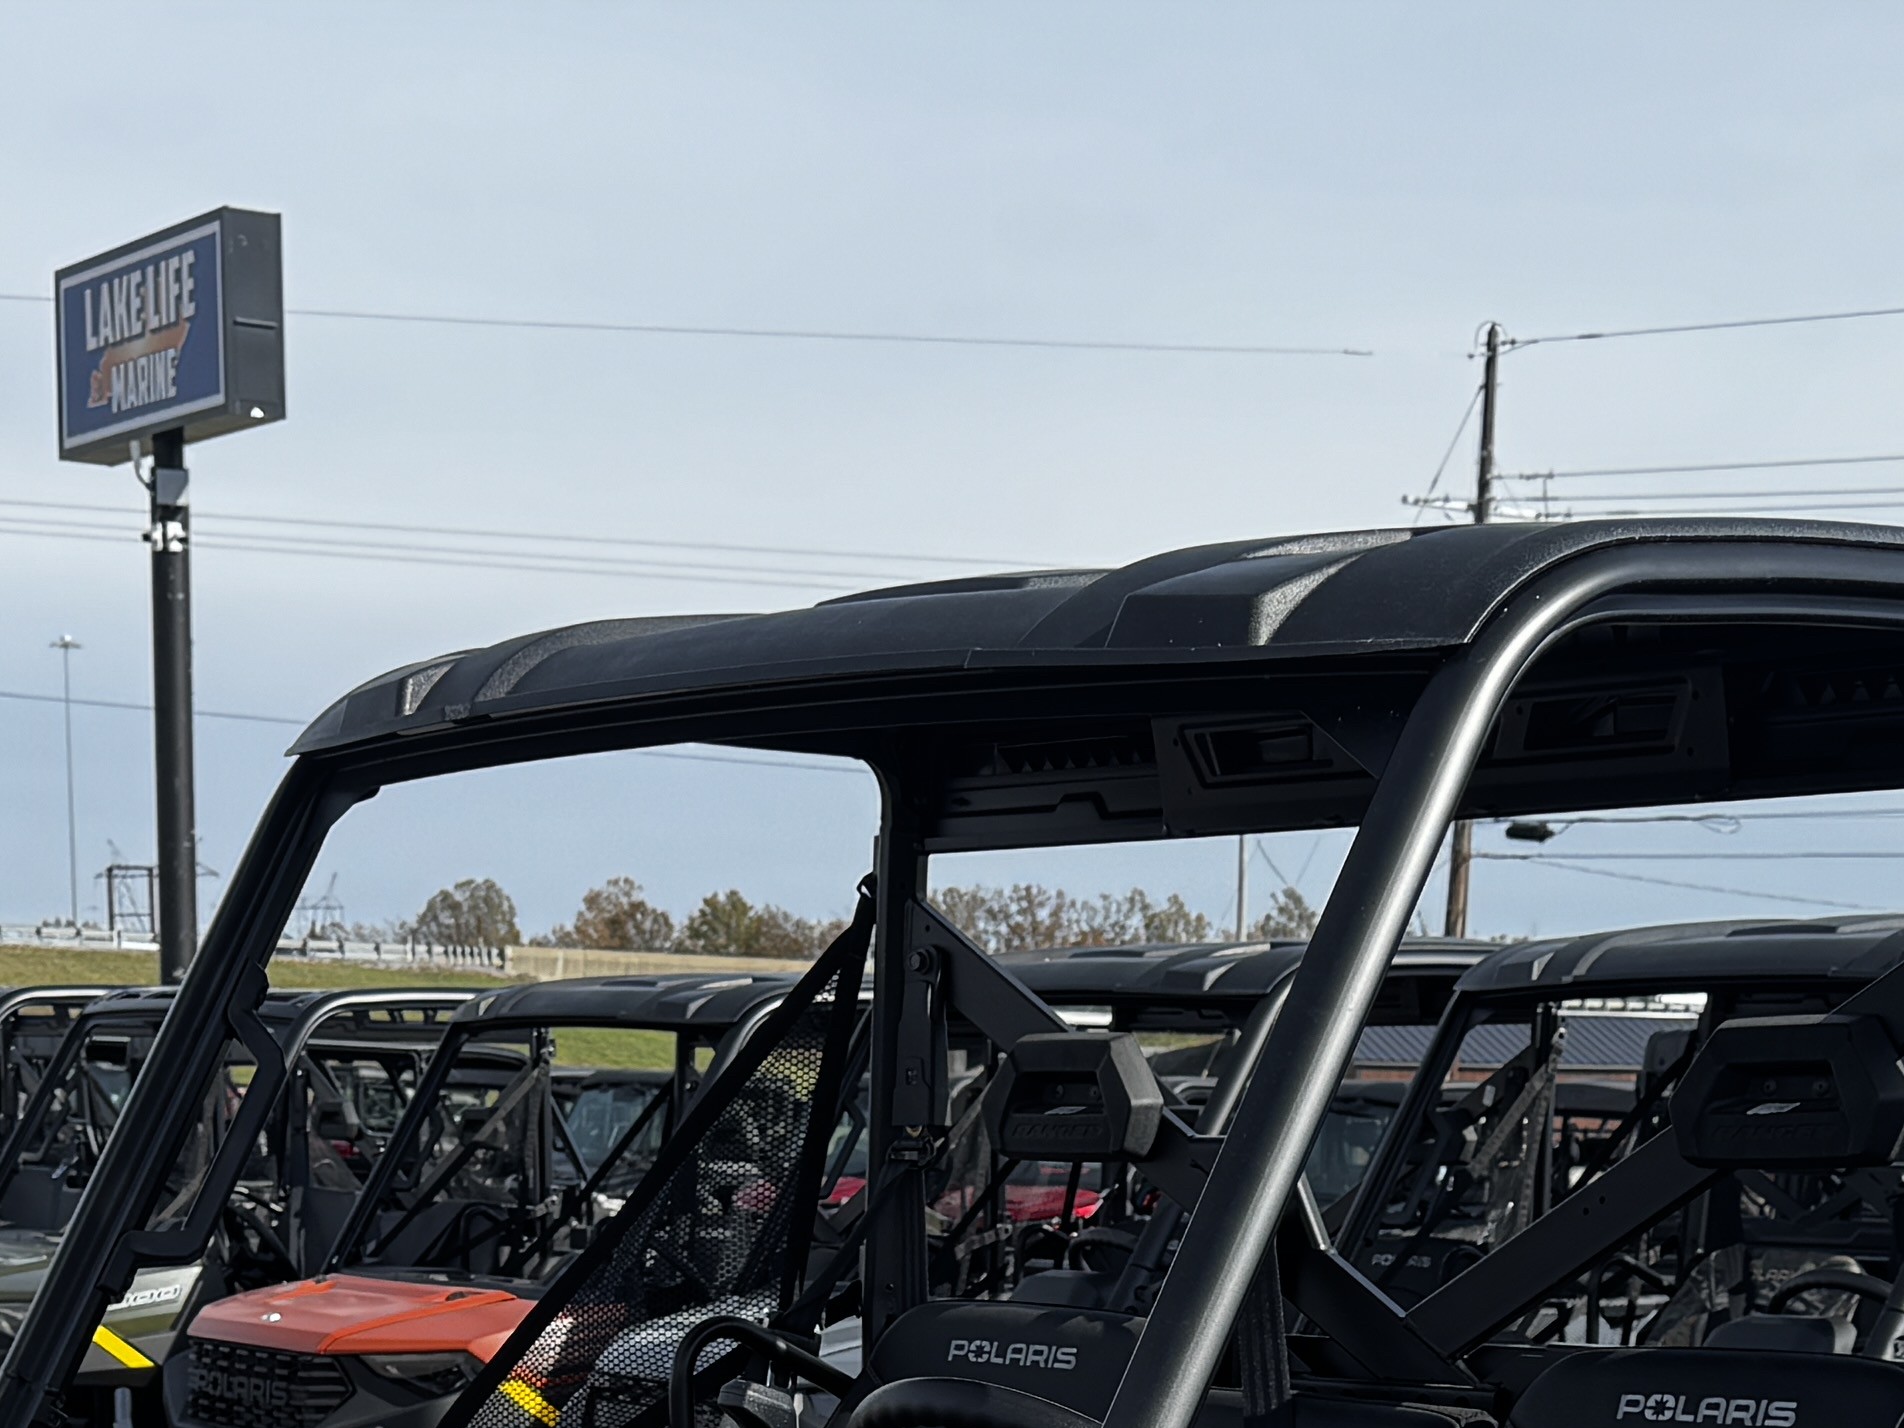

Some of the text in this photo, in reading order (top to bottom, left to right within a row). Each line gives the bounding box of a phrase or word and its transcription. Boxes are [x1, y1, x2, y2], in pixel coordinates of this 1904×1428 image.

[84, 250, 196, 351] LAKE LIFE
[111, 347, 178, 413] MARINE
[947, 1339, 1078, 1370] POLARIS
[188, 1367, 288, 1407] POLARIS
[1616, 1393, 1798, 1427] POLARIS
